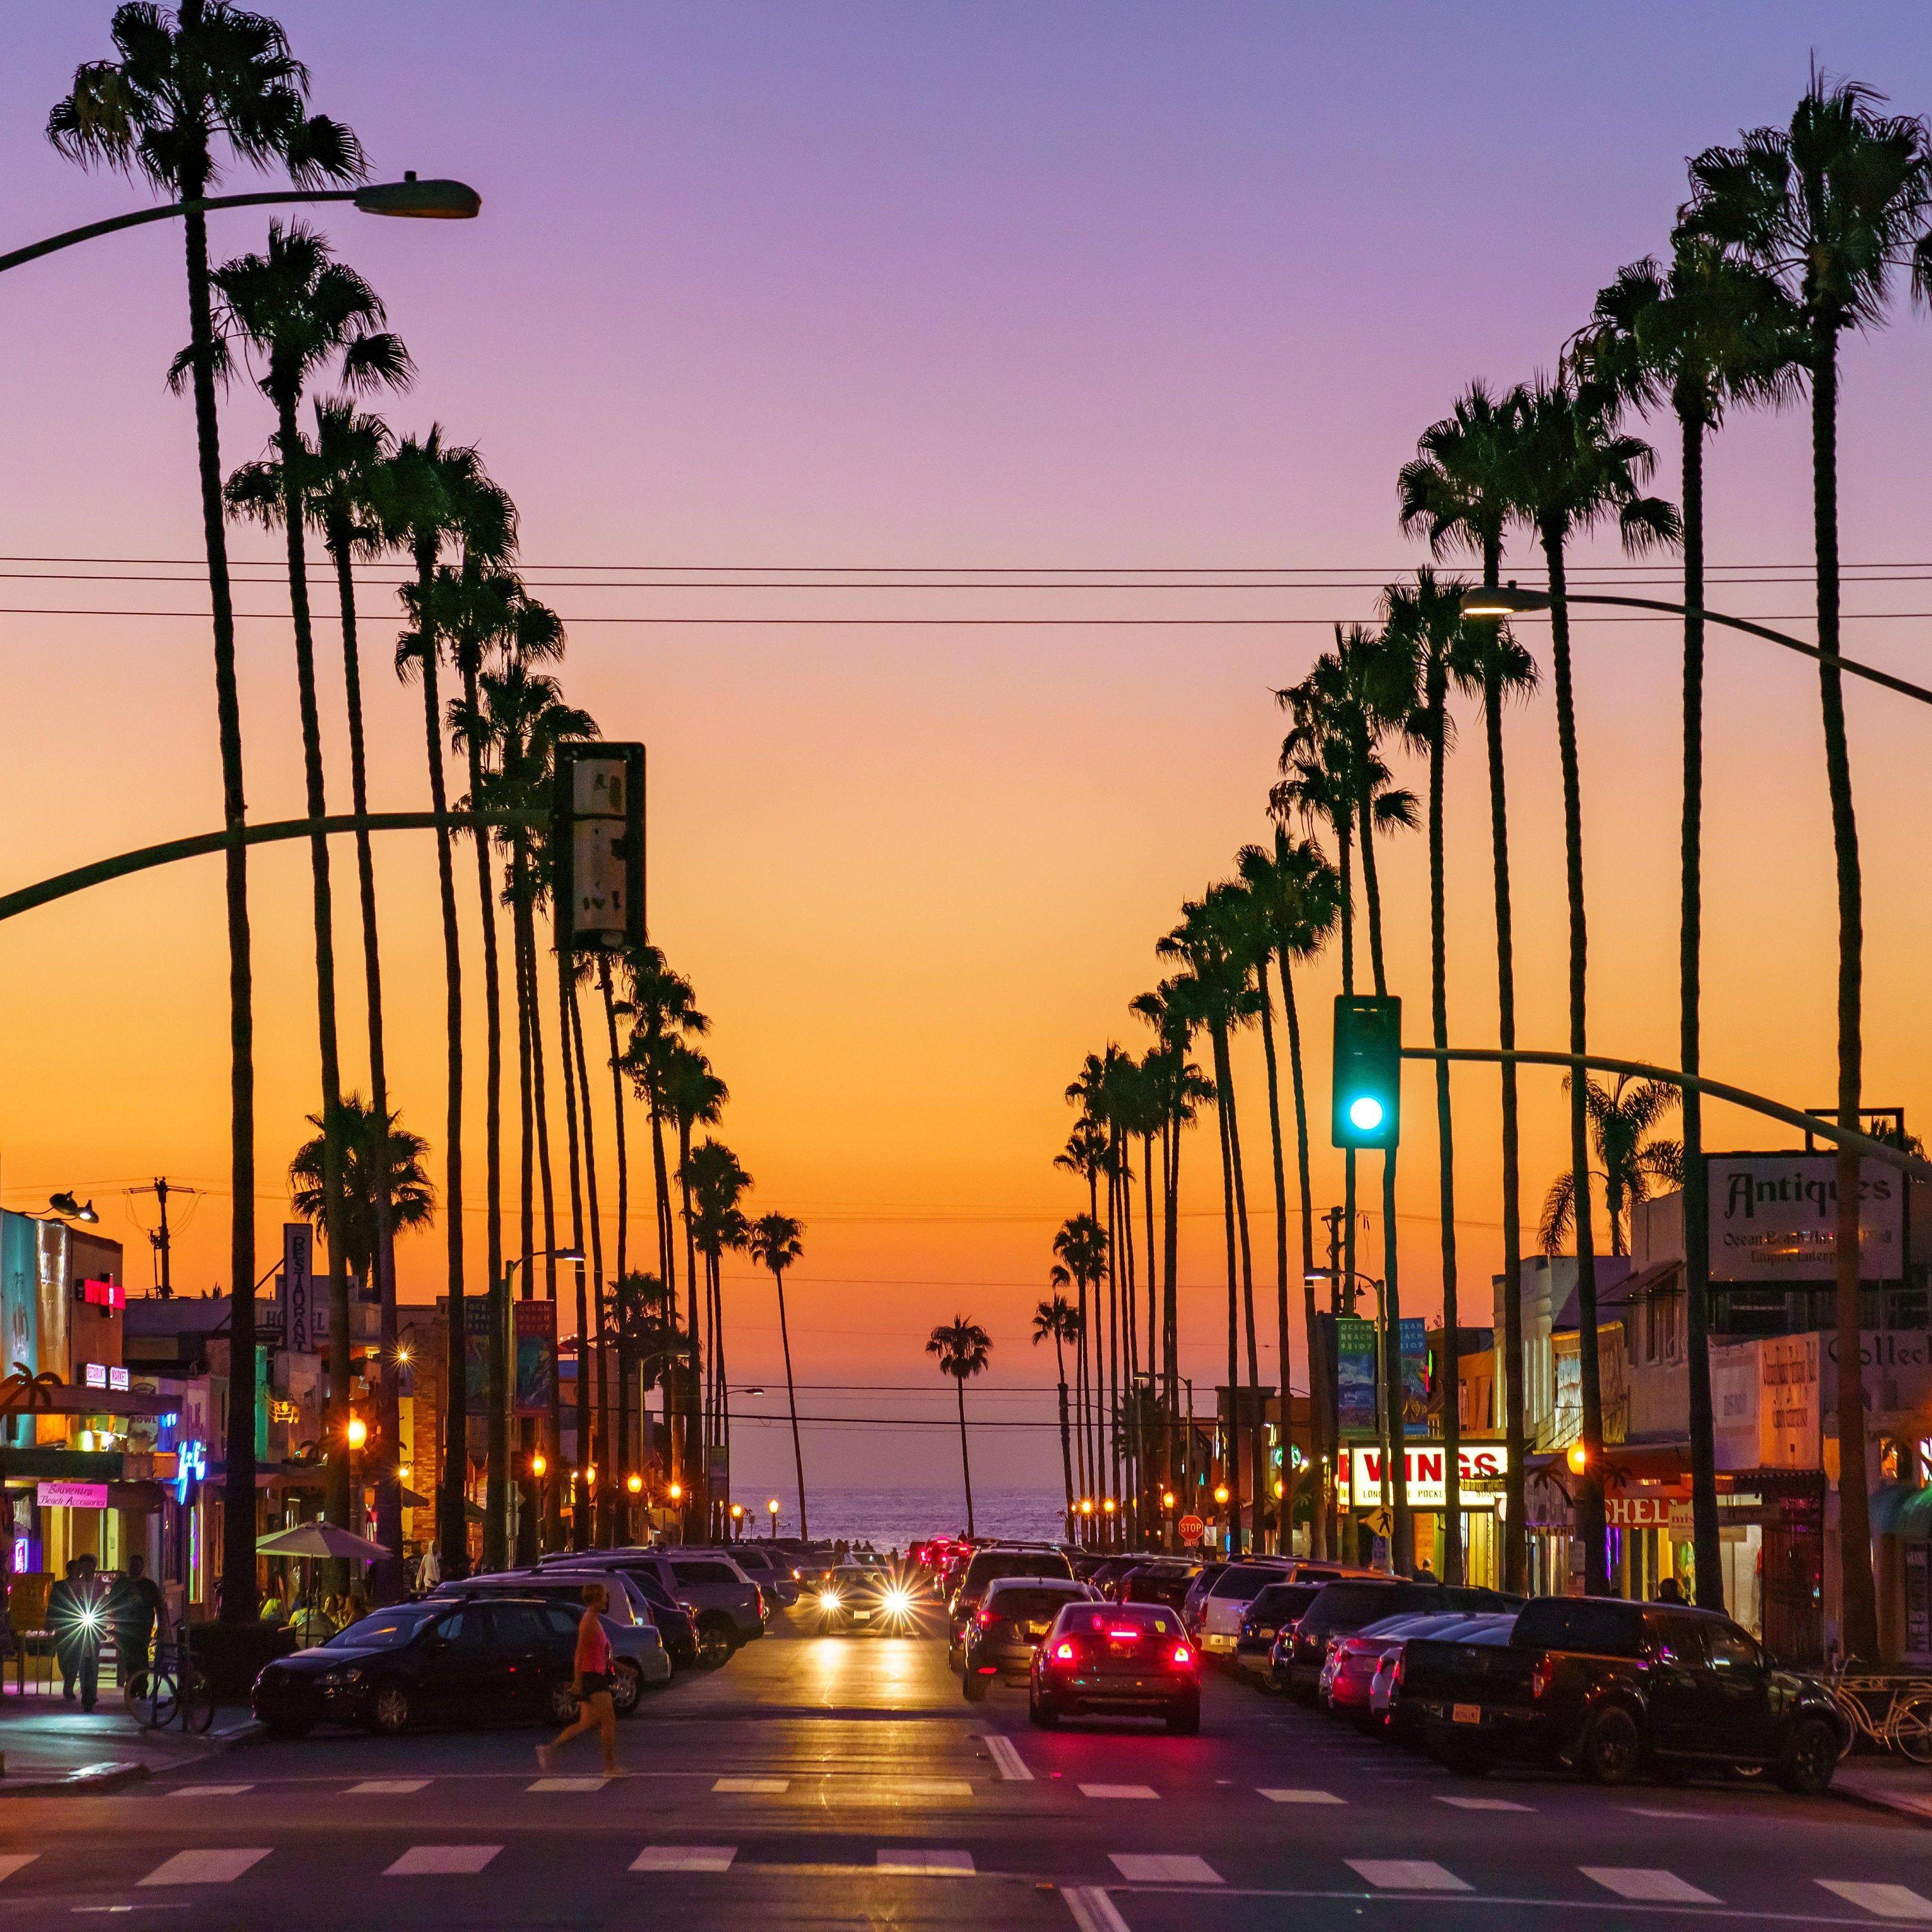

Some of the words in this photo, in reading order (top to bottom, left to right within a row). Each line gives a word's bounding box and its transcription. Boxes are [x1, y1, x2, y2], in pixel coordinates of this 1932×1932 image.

[292, 1236, 306, 1352] RESTAURANT
[48, 1484, 93, 1496] Souvenirs
[39, 1495, 63, 1505] Beach
[66, 1496, 105, 1506] Accessories
[1180, 1522, 1202, 1533] STOP
